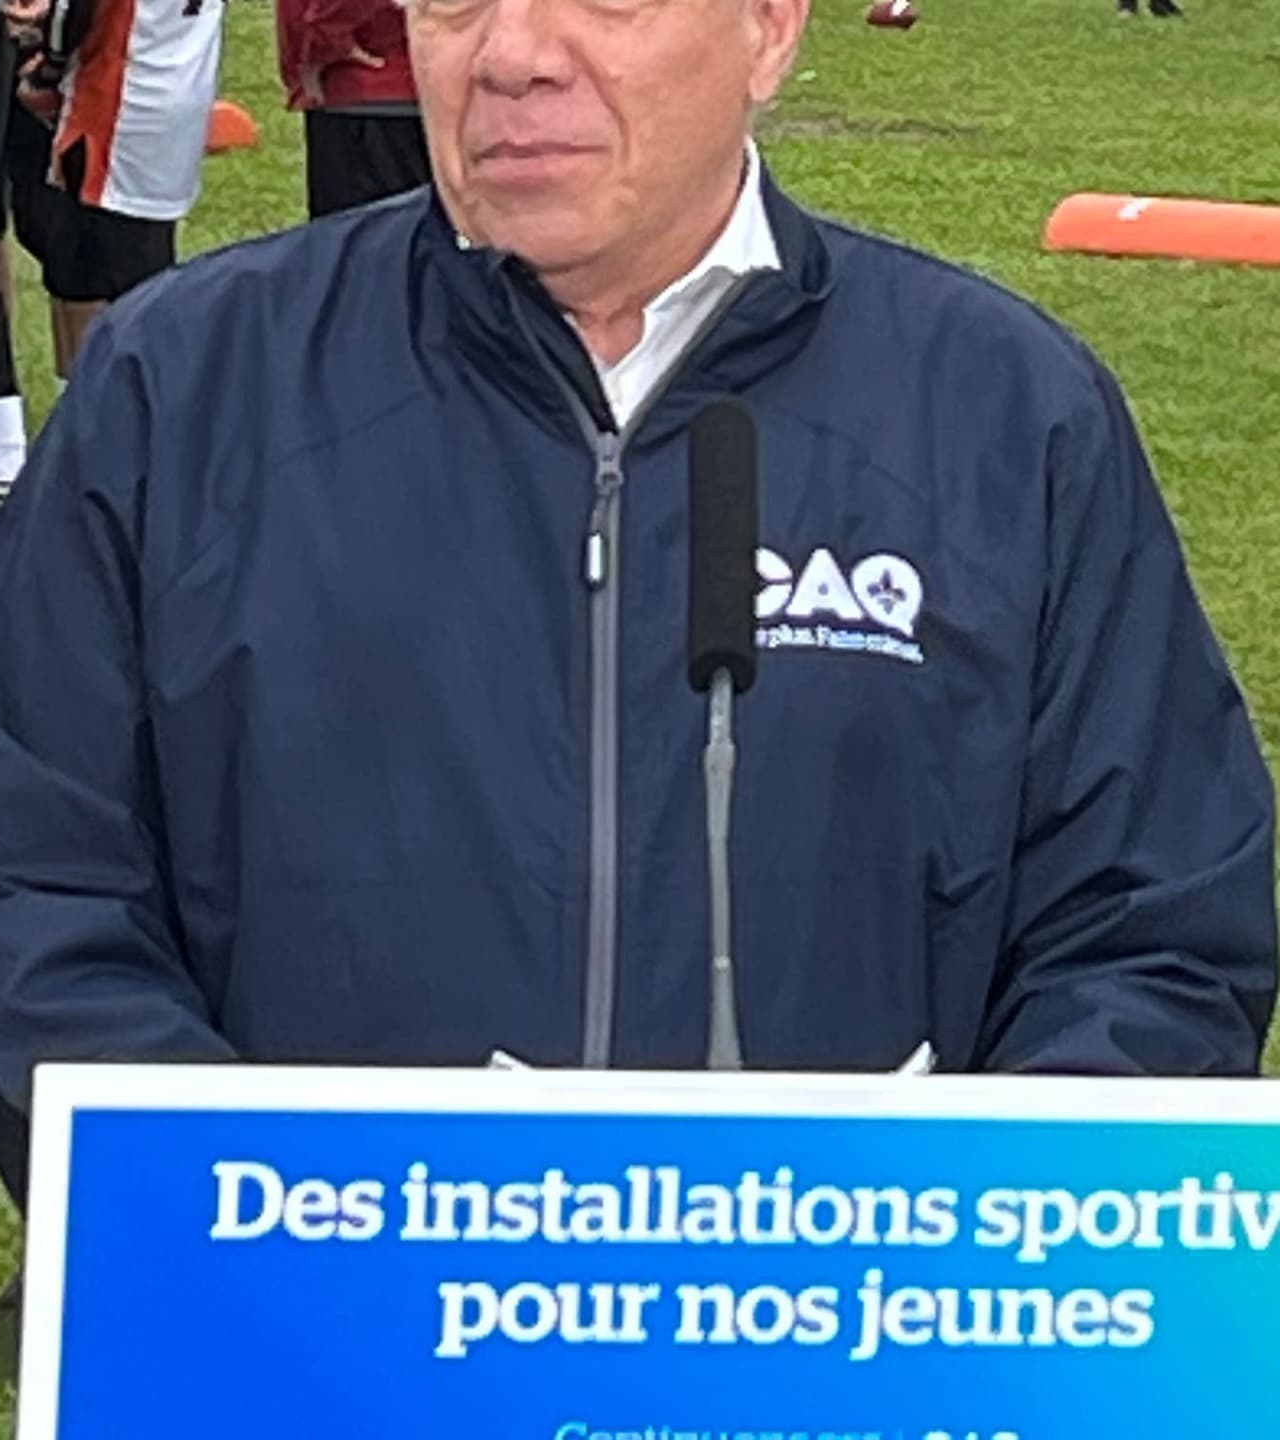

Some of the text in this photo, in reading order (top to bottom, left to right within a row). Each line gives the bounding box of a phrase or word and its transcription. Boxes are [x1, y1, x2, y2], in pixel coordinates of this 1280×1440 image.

[209, 1160, 386, 1241] Des
[399, 1160, 959, 1246] installations
[433, 1267, 1155, 1362] pour nos jeunes
